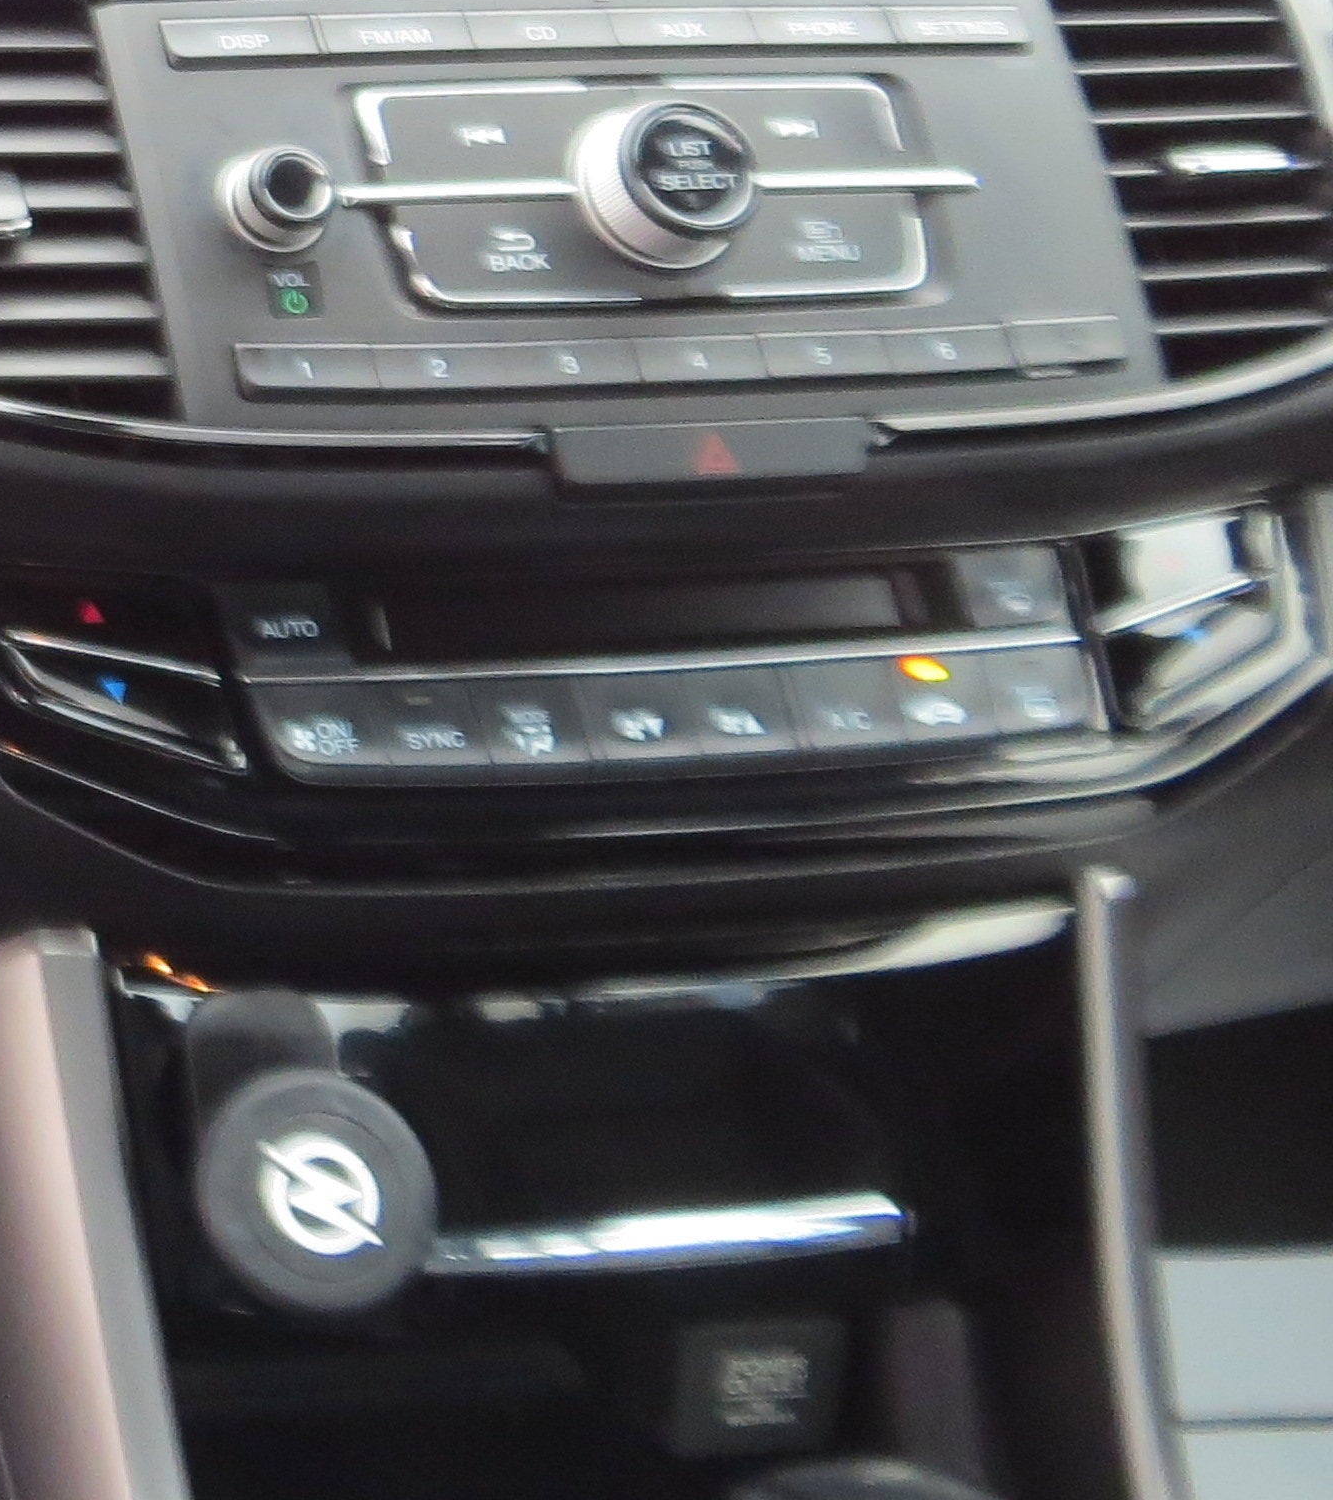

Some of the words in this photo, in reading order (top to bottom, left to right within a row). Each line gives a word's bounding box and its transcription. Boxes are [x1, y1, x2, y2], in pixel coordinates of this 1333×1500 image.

[357, 27, 435, 47] FM/AM
[524, 25, 558, 41] CD
[661, 20, 708, 38] AUX
[217, 32, 272, 52] DISP
[665, 139, 713, 160] LIST
[658, 171, 739, 192] SELECT
[486, 252, 553, 274] BACK
[268, 271, 311, 287] VOL
[812, 345, 834, 367] 5
[935, 340, 959, 362] 6
[427, 355, 450, 381] 2
[259, 617, 320, 639] AUTO
[406, 728, 466, 752] SYNC
